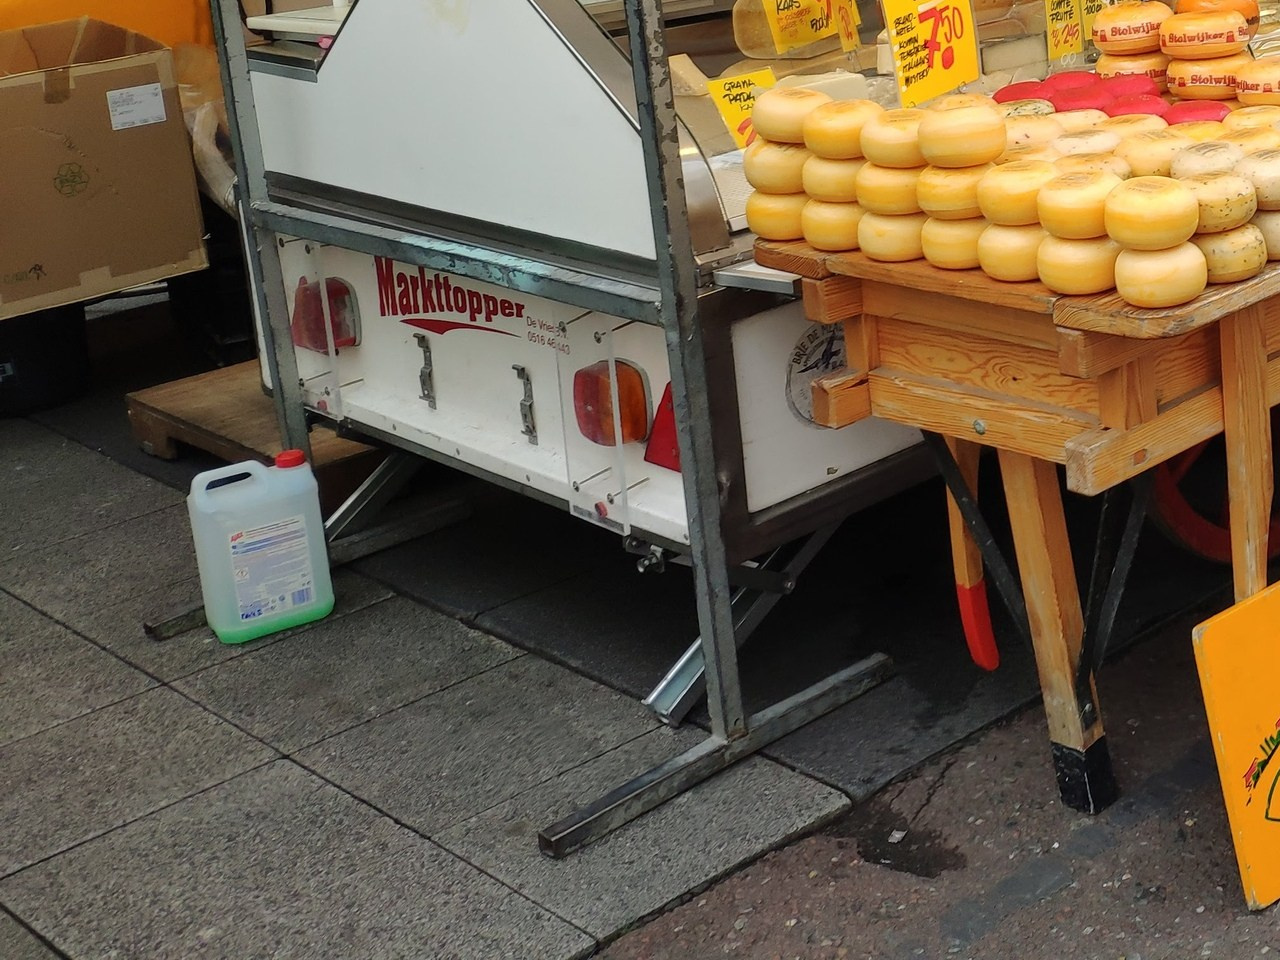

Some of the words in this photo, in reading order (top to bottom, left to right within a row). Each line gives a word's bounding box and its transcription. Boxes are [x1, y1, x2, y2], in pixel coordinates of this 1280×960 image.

[1110, 21, 1162, 37] Stolwijke
[1168, 31, 1225, 45] Stolwijker
[374, 256, 525, 323] Markttopper
[526, 316, 537, 328] De
[792, 341, 809, 365] BRIE
[807, 329, 819, 344] DE
